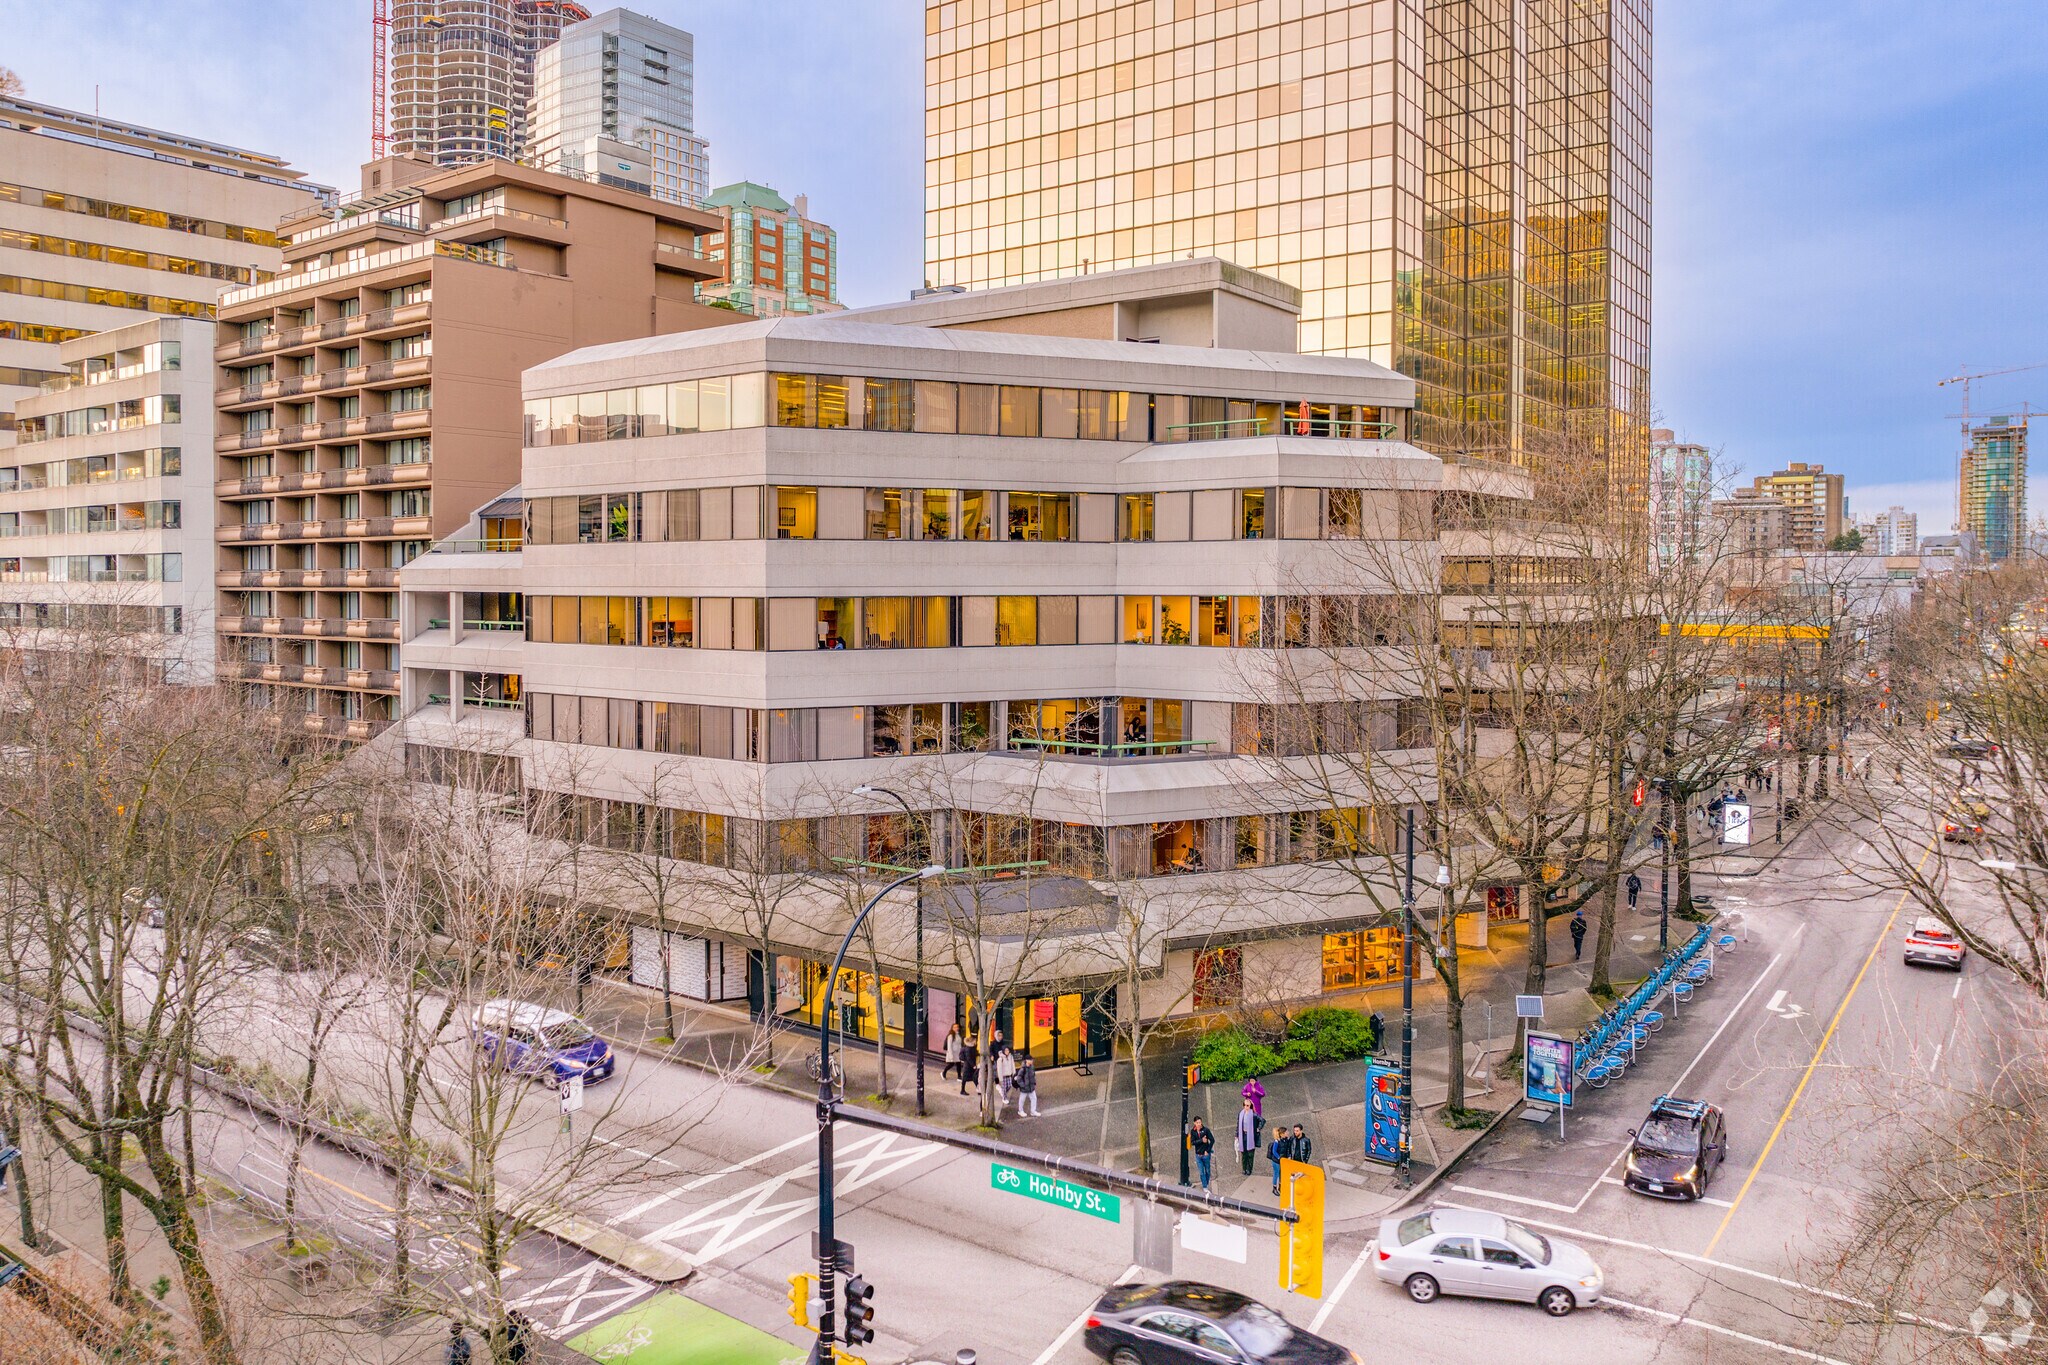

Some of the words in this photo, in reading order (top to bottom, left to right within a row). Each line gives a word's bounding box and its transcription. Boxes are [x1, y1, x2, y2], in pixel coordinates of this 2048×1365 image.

[1373, 1058, 1391, 1067] Hornby
[1029, 1175, 1082, 1209] Hornby
[1085, 1191, 1106, 1213] St.
